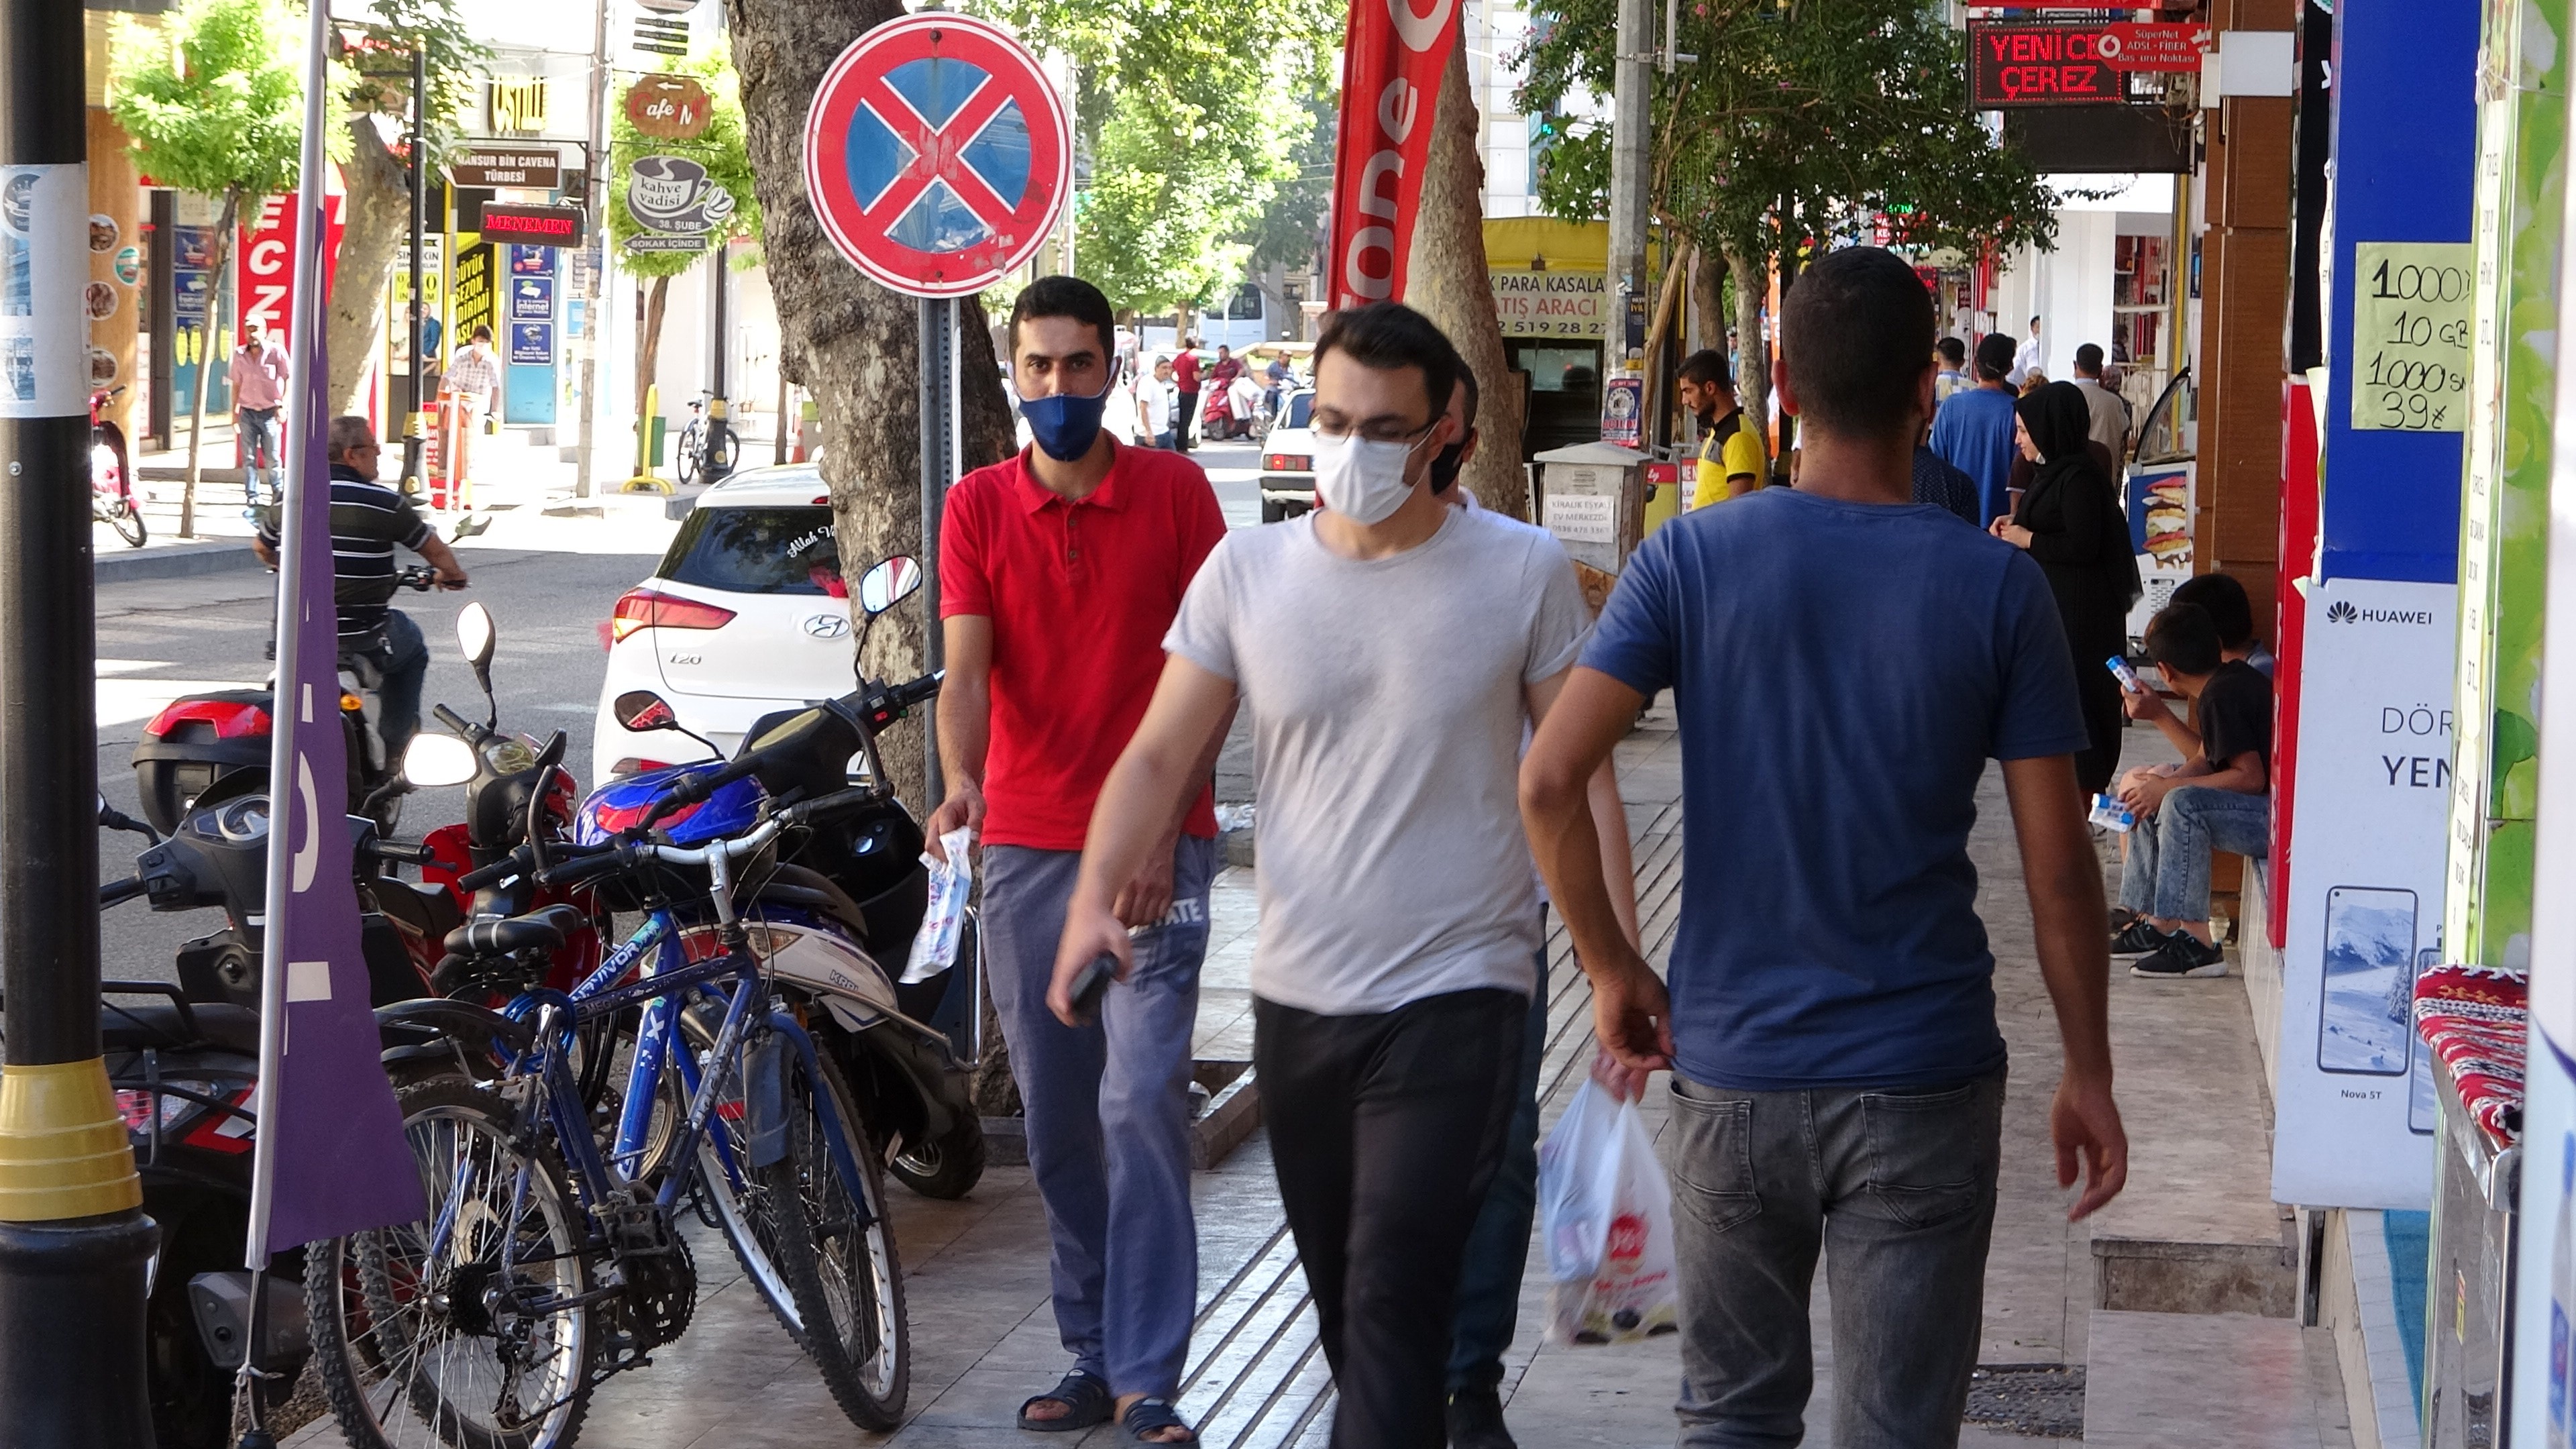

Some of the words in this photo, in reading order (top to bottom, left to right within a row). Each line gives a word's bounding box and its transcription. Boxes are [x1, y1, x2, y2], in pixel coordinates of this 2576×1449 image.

[2127, 40, 2151, 51] ADSL
[2159, 39, 2187, 52] FİBER
[2159, 53, 2195, 63] Noktası
[2000, 65, 2098, 100] ÇEREZ
[631, 91, 675, 120] Cafe
[498, 154, 517, 167] BİN
[518, 156, 556, 168] CAVENA
[484, 169, 526, 182] TÜRBESİ
[641, 177, 682, 194] kahve
[1342, 76, 1419, 309] one
[639, 193, 680, 207] vadisi
[485, 214, 574, 235] MENEMEN
[674, 220, 702, 231] ŞUBE
[631, 239, 666, 248] SOKAK
[667, 238, 701, 249] İÇİNDE
[1501, 276, 1541, 292] PARA
[1546, 276, 1606, 293] KASALA
[1493, 297, 1529, 319] ATIŞ
[1535, 298, 1597, 317] ARACI
[1514, 321, 1550, 333] 519
[1558, 322, 1581, 334] 28
[2386, 311, 2432, 347] 10
[2365, 350, 2446, 392] 1000
[786, 531, 819, 558] Allah
[2362, 608, 2432, 625] HUAWEI
[2381, 702, 2453, 737] DÖR
[2381, 755, 2452, 789] YEN
[2341, 1089, 2367, 1099] Nova
[2369, 1090, 2382, 1100] 5T
